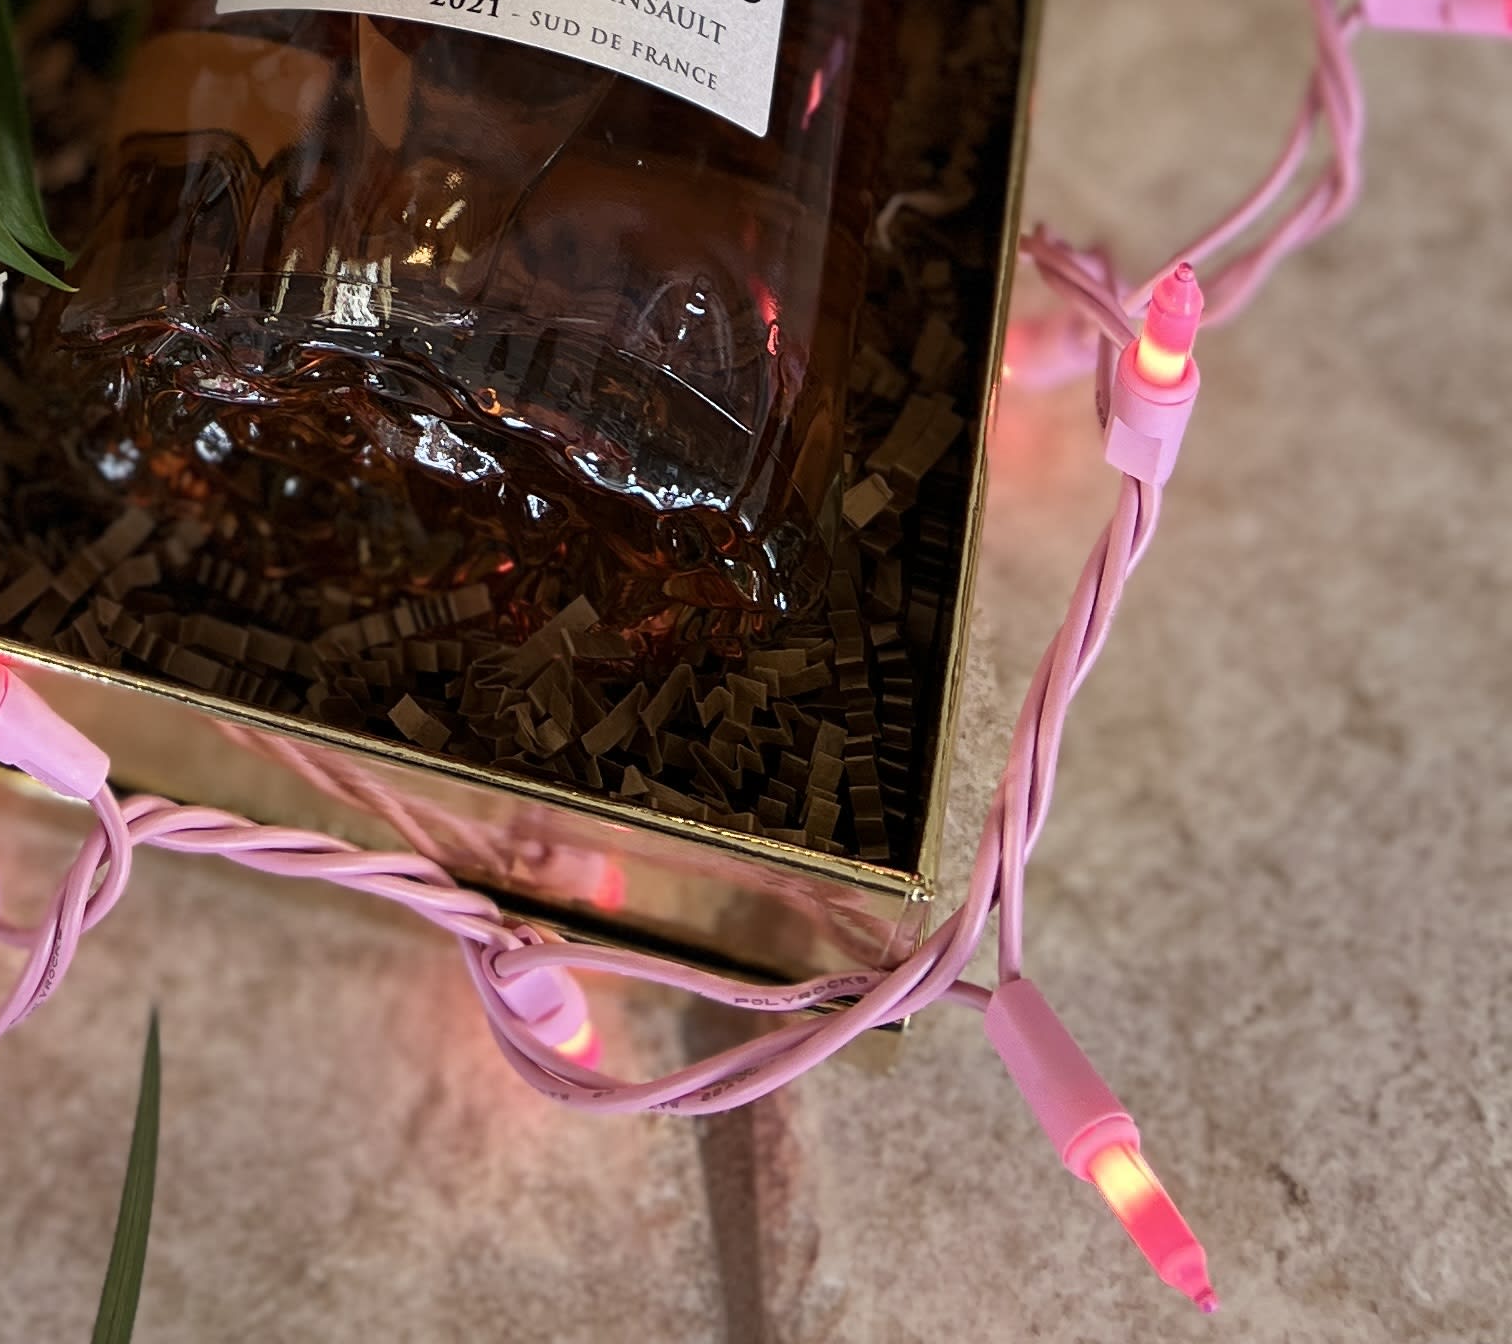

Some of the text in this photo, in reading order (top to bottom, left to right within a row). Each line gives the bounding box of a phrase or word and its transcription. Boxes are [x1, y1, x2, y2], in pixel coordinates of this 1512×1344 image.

[529, 10, 580, 37] SUD
[591, 26, 623, 50] DE
[631, 40, 718, 91] FRANCE
